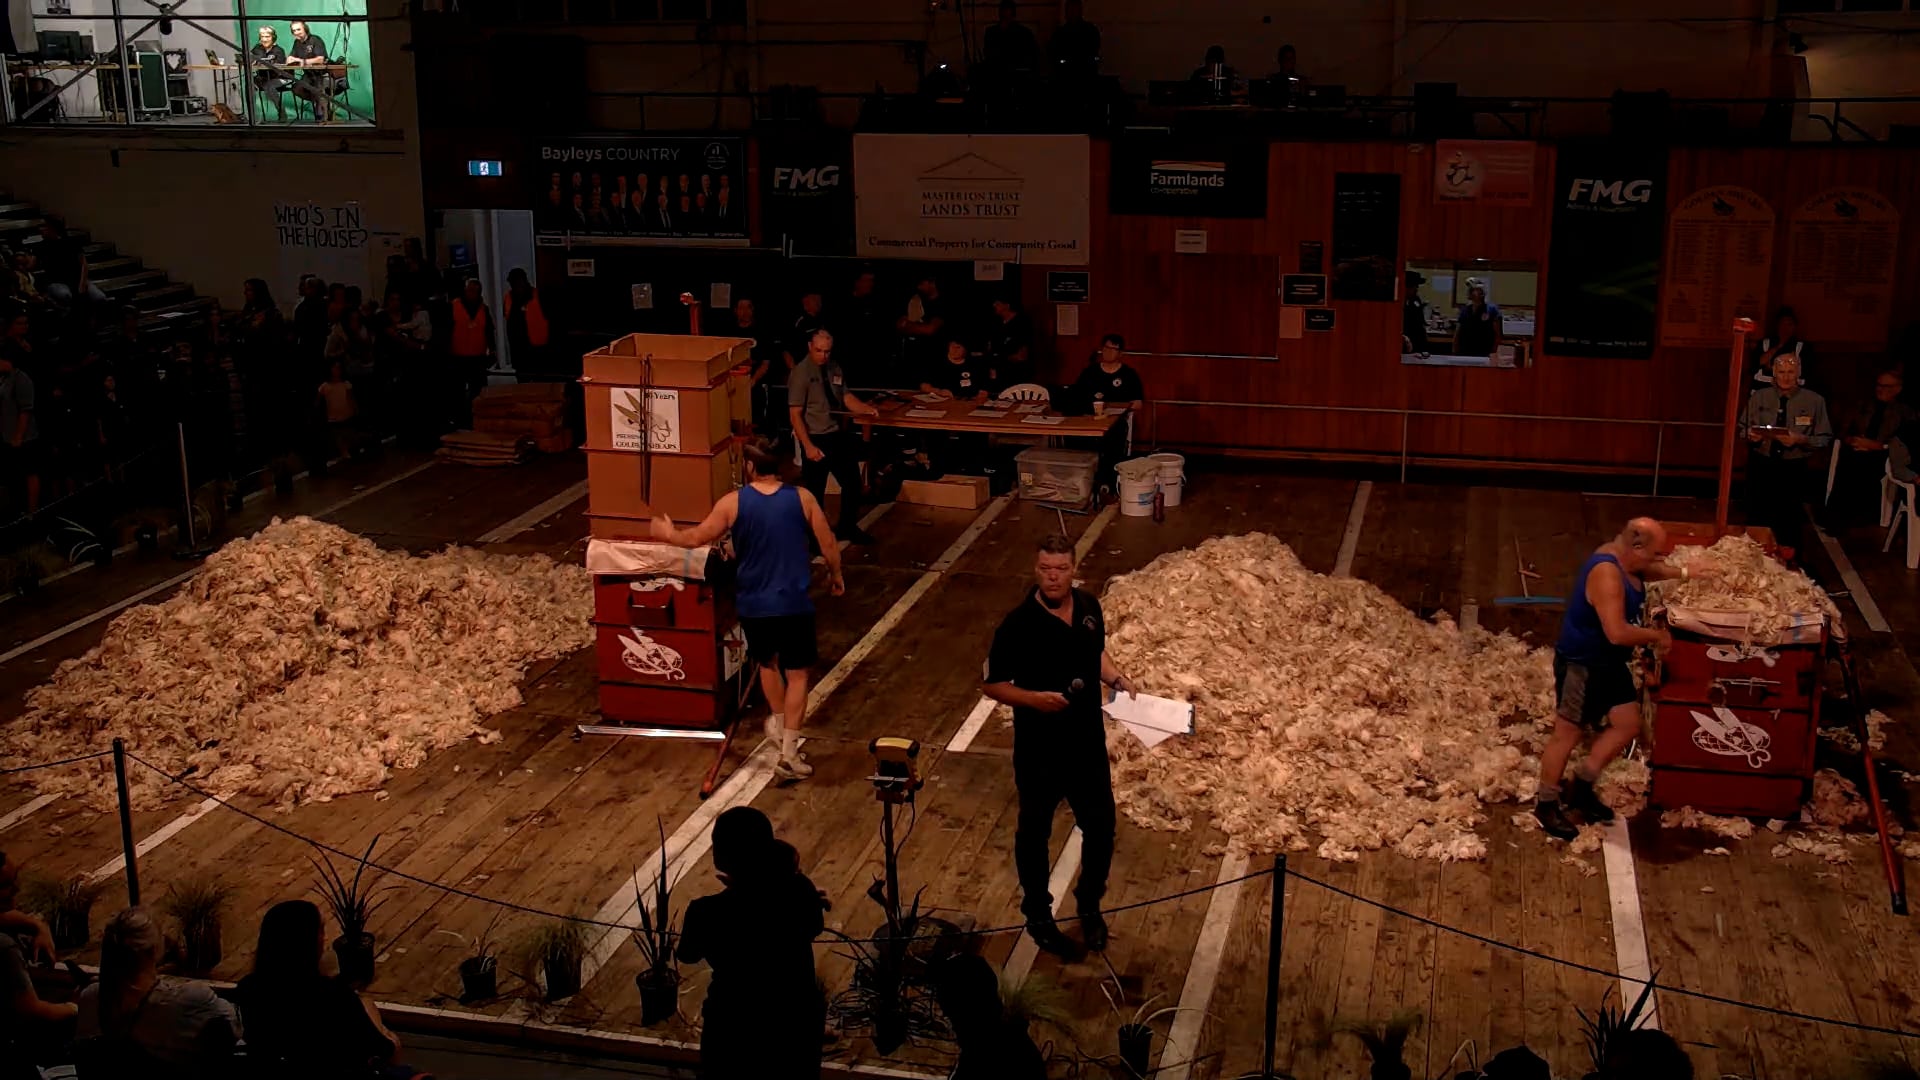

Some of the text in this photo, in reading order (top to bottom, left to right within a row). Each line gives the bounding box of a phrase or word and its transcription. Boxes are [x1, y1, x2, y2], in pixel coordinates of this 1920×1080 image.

[541, 146, 681, 162] Bayleys COUNTRY
[773, 165, 841, 190] FMG
[1150, 172, 1225, 187] Farmlands
[921, 191, 1021, 201] MASTERTON TRUST
[1568, 178, 1653, 205] FMG
[274, 205, 360, 229] WHO'S IN
[922, 203, 1021, 217] LANDS TRUST
[868, 236, 1077, 251] Commercial Property for Community Good
